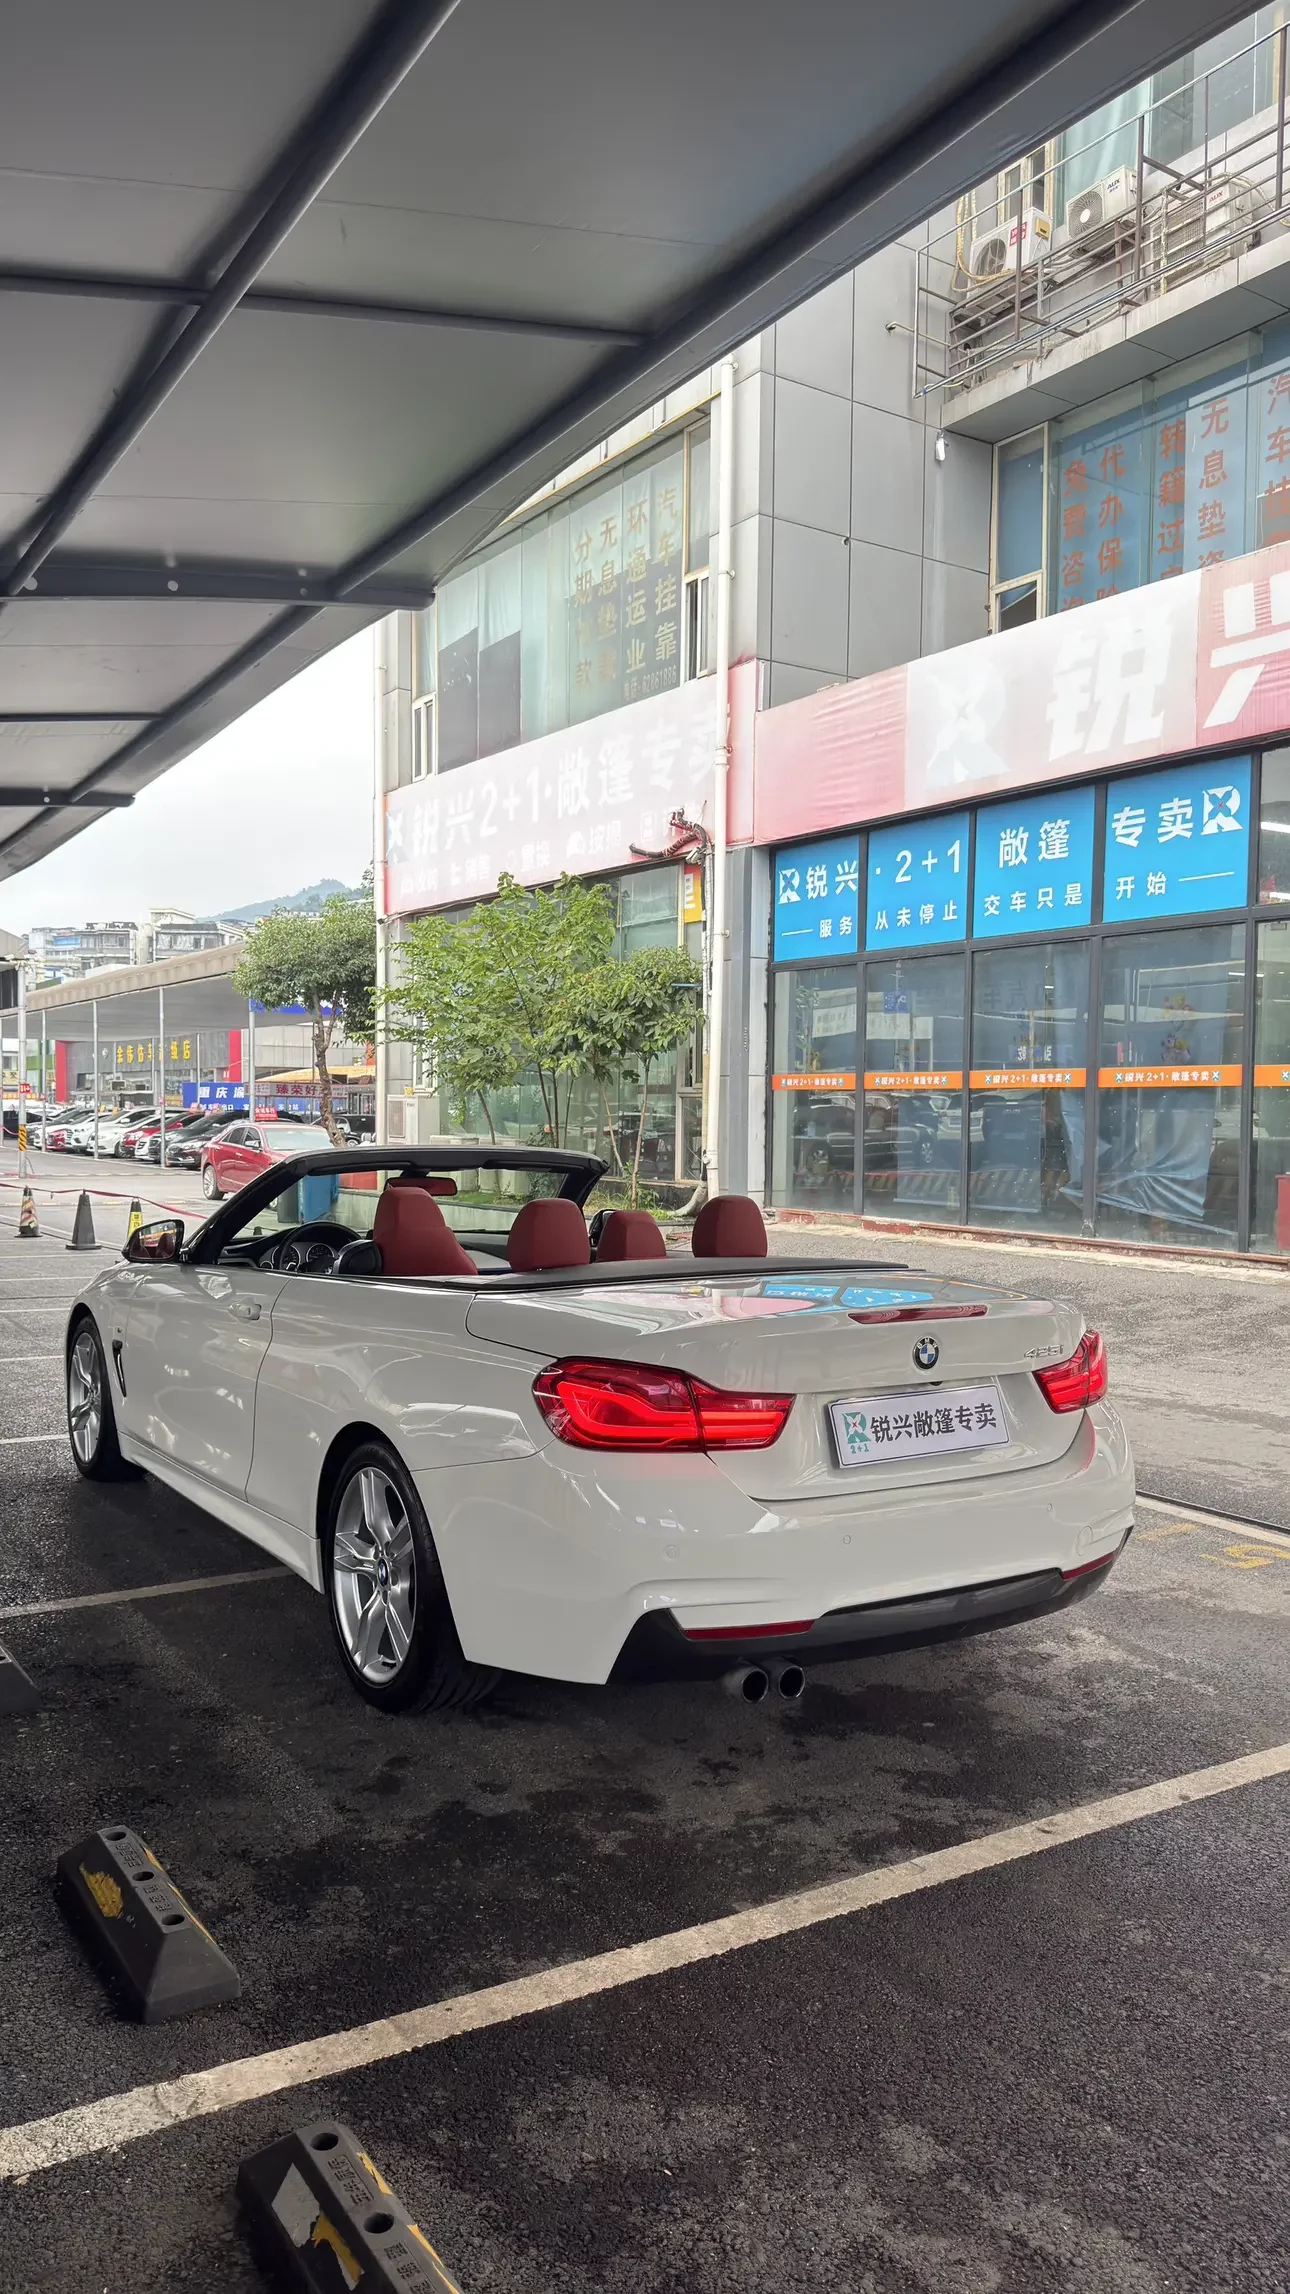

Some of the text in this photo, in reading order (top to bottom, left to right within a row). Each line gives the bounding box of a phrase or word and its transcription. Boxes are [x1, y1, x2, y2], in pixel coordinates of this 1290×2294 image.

[1107, 178, 1120, 190] AUX
[624, 498, 648, 674] 环通运业
[654, 487, 679, 661] 汽车挂靠
[806, 860, 858, 900] 锐兴
[999, 818, 1070, 868] 敞篷
[1111, 797, 1194, 848] 专卖
[819, 871, 1167, 938] 服务 从未停止 交车只是 开始
[850, 1442, 870, 1455] 2+1
[870, 1402, 997, 1444] 锐兴敞篷专卖
